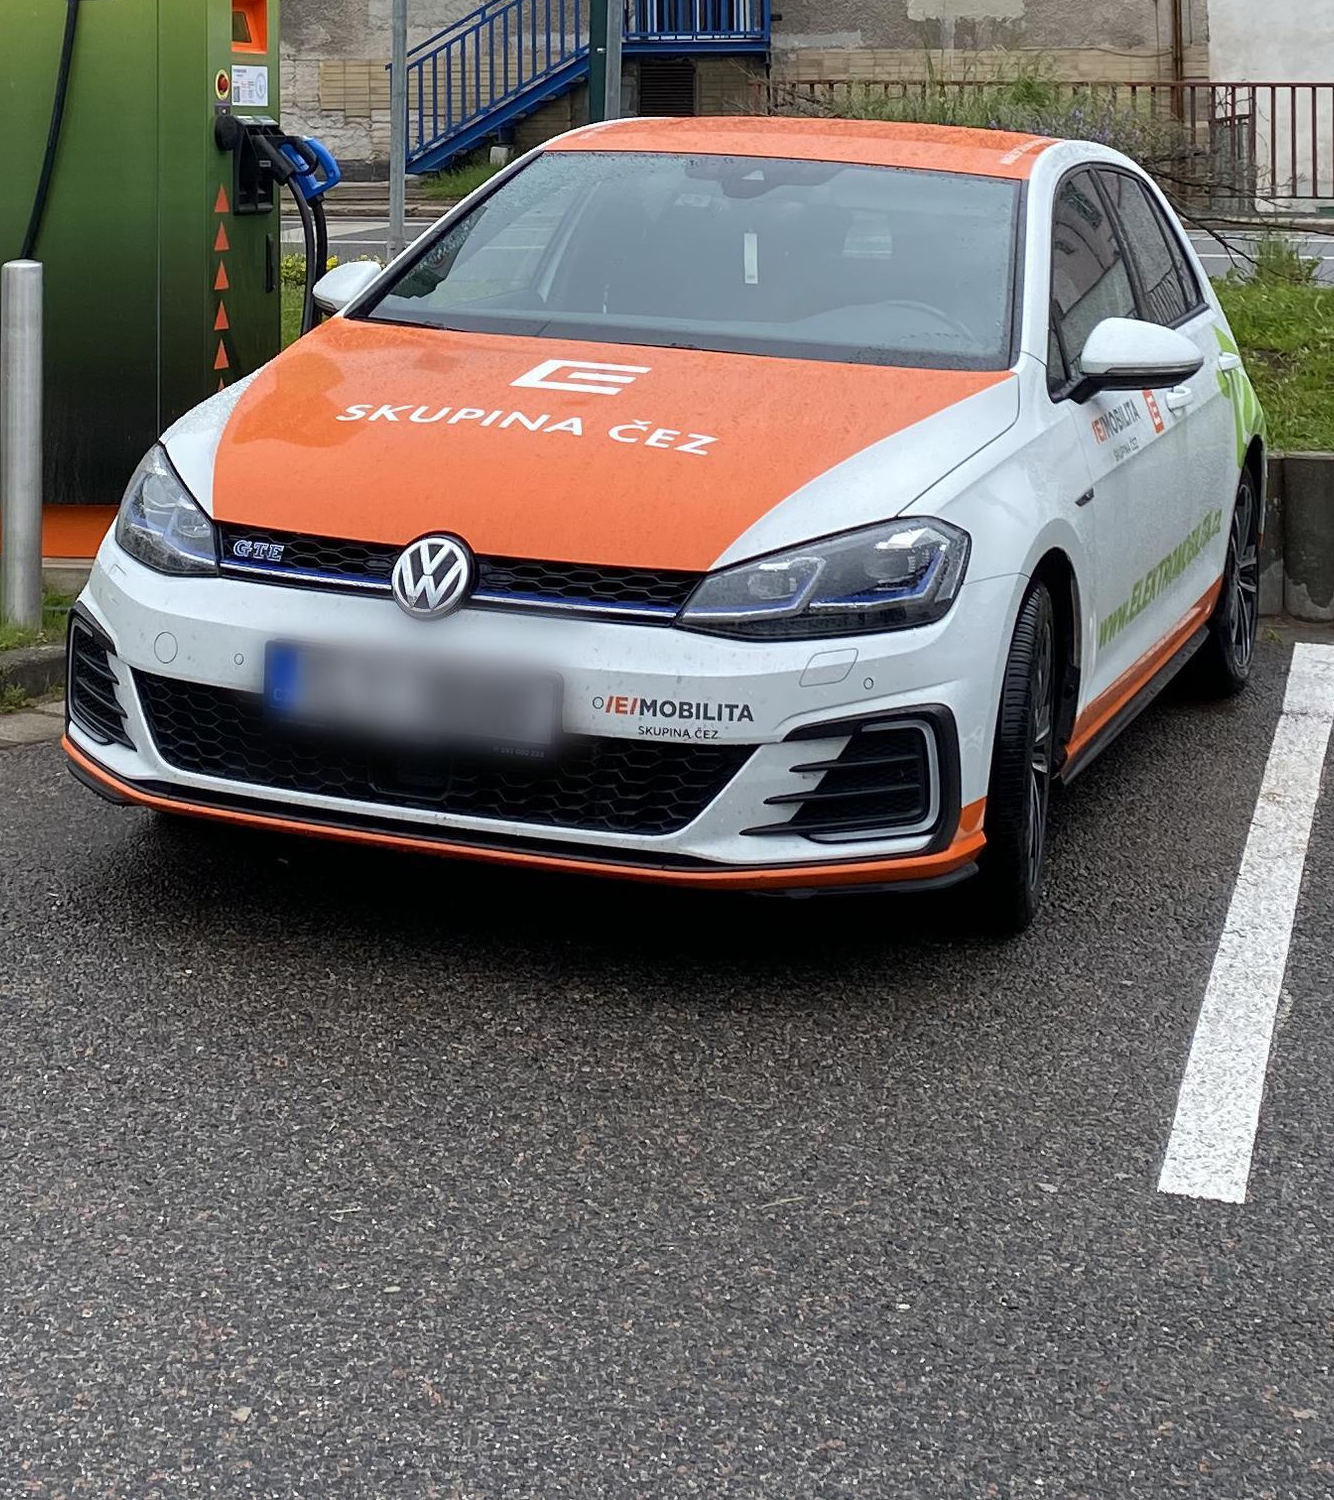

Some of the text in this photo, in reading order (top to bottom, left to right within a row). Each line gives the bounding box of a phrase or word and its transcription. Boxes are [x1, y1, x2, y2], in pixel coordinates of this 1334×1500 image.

[335, 403, 720, 456] SKUPINA ČEZ
[233, 539, 285, 561] GTE
[638, 726, 719, 740] SKUPINA ČEZ
